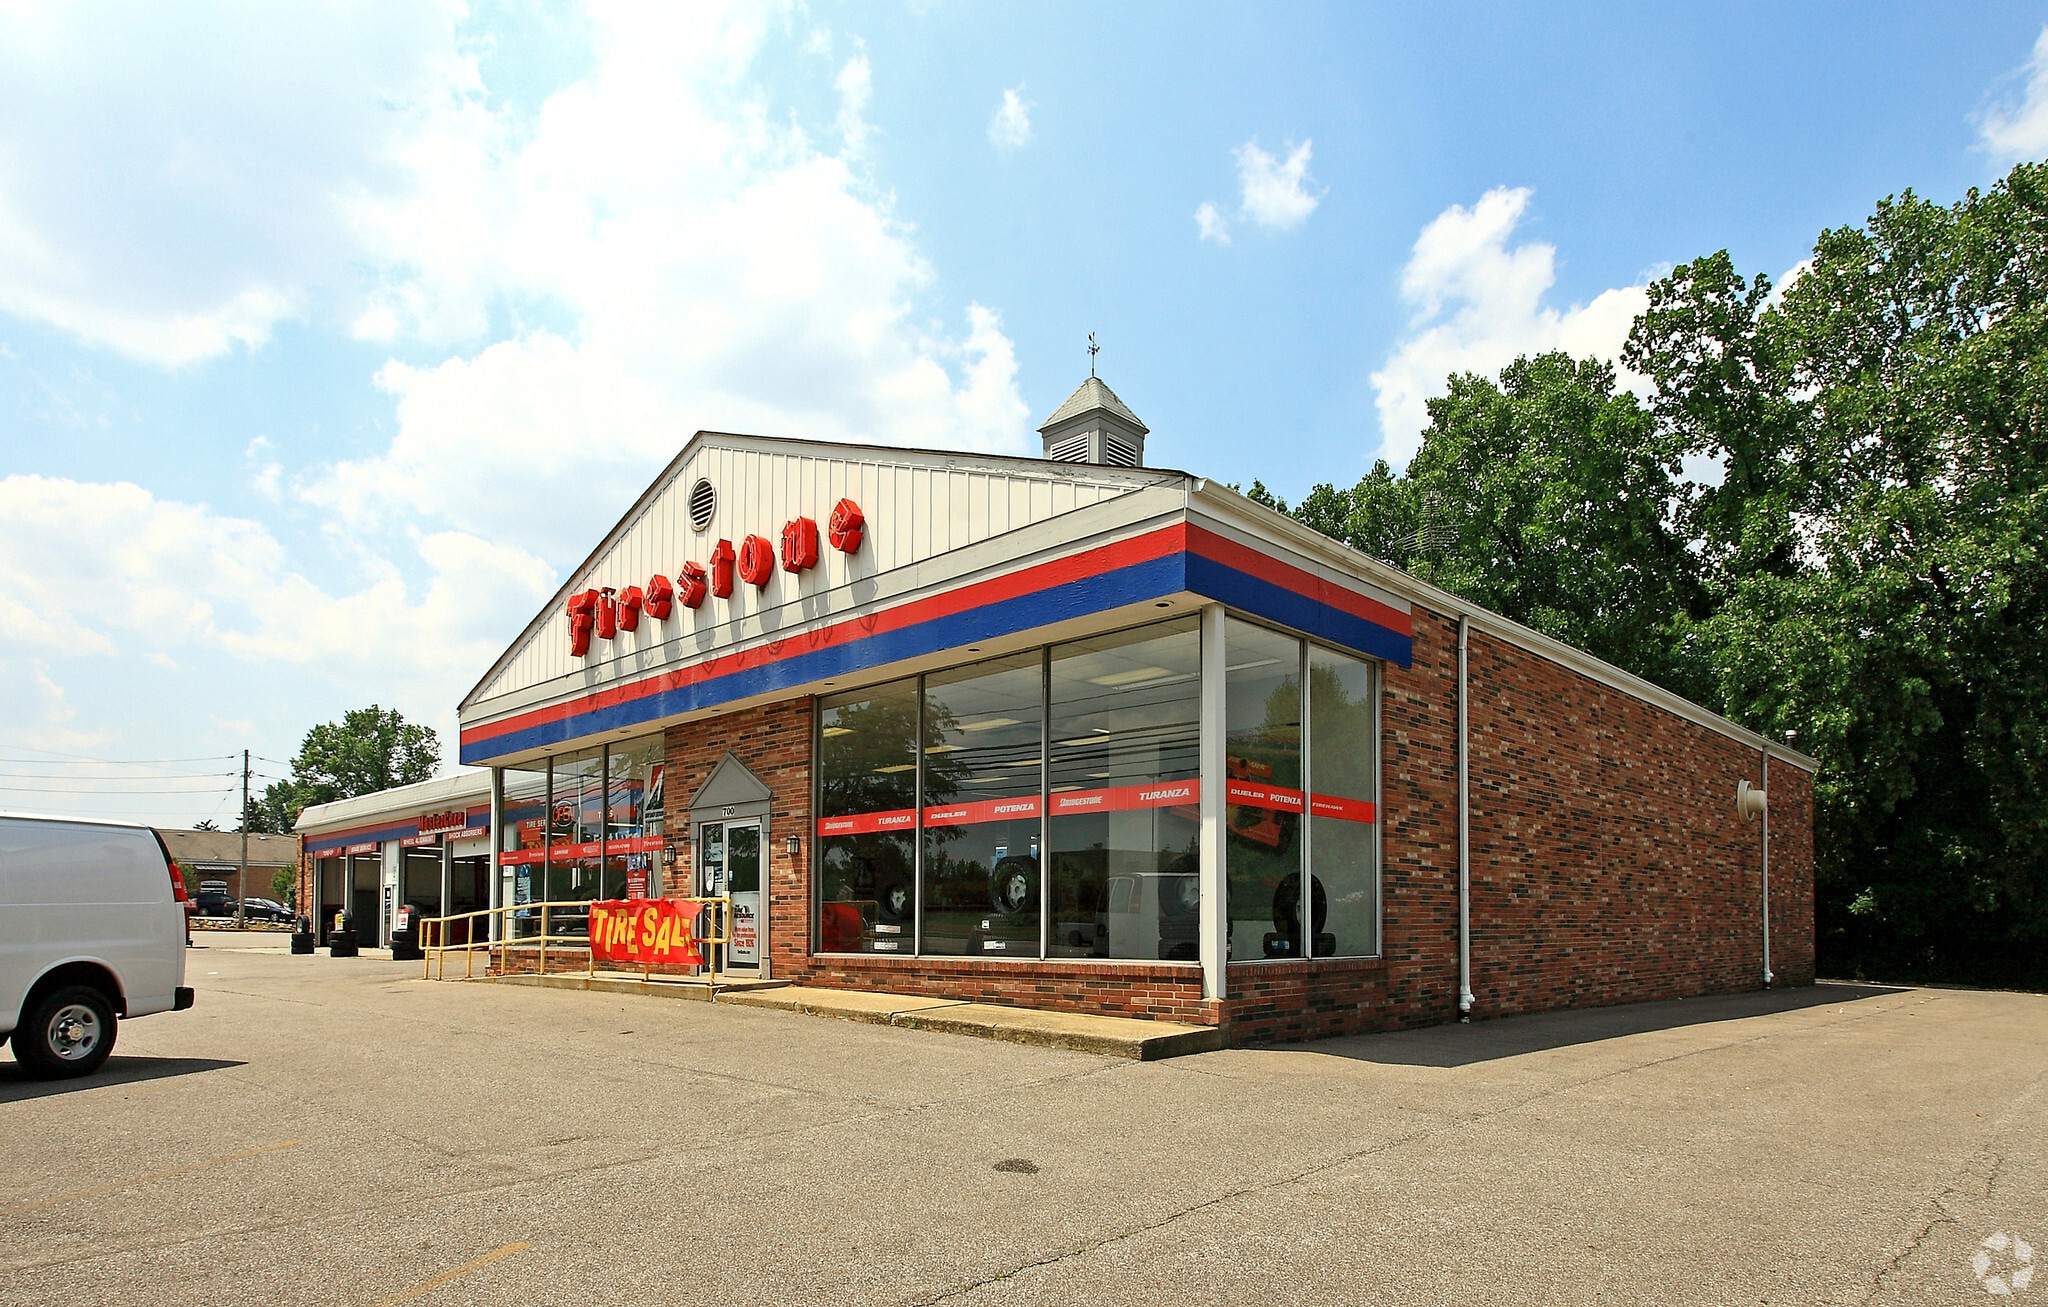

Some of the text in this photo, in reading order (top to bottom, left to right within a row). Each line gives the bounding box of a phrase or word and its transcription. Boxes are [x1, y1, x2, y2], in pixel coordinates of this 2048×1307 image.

[566, 498, 865, 657] Firestone
[1139, 788, 1190, 801] TURANZA
[1231, 788, 1265, 799] DUELER
[1270, 793, 1302, 806] POTENZA
[722, 807, 735, 816] 700
[994, 803, 1035, 814] POTENZA
[878, 816, 911, 825] TURANZA
[930, 811, 967, 819] DUELER
[593, 907, 699, 956] TIRE SALE
